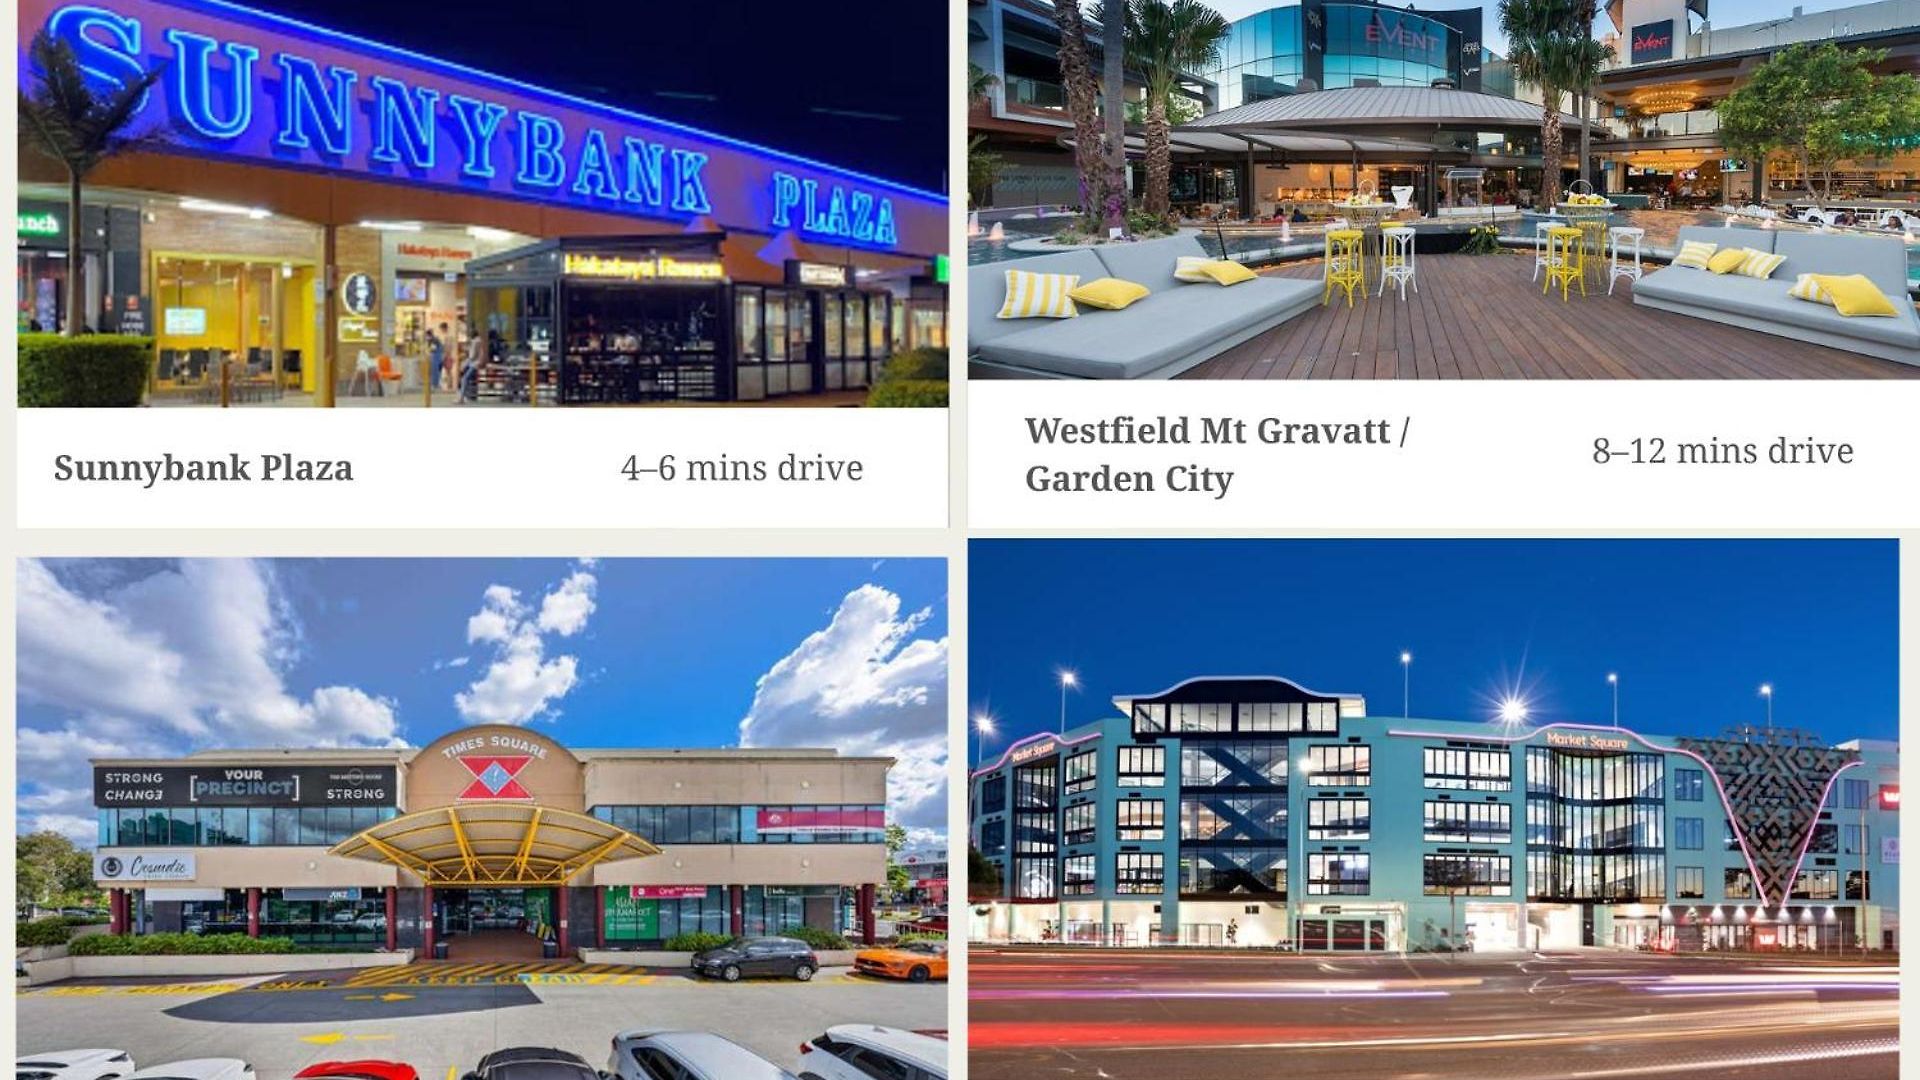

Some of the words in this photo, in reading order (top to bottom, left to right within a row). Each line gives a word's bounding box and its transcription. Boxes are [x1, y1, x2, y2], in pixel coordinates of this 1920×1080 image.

[1365, 13, 1441, 50] EVENT
[773, 171, 897, 244] PLAZA
[441, 737, 485, 759] TIMES
[491, 735, 548, 760] SQUARE
[1547, 731, 1586, 746] Market
[1590, 735, 1629, 750] Square
[105, 773, 163, 783] STRONG
[225, 769, 263, 780] YOUR
[327, 788, 385, 799] STRONG
